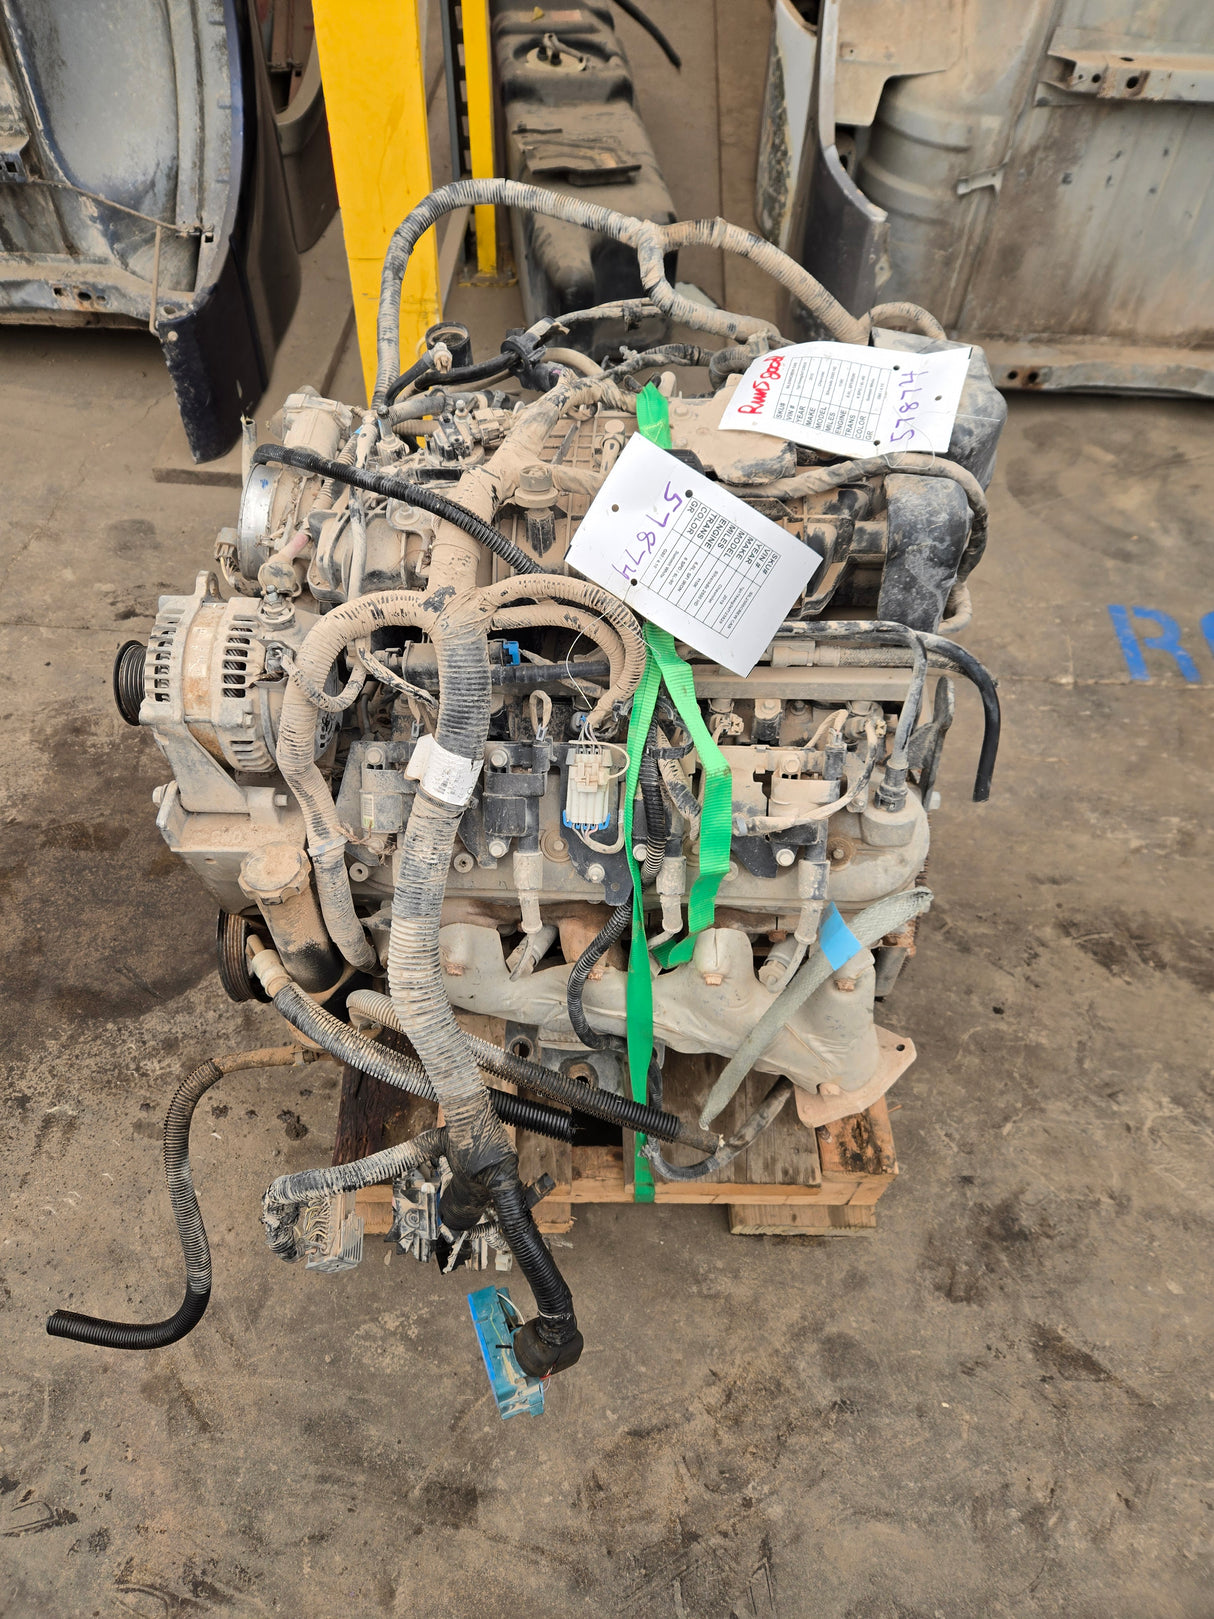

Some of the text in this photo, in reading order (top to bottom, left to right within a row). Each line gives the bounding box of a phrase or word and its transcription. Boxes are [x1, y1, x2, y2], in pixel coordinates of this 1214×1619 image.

[775, 401, 786, 419] SKU#
[785, 409, 794, 421] VIN
[794, 405, 806, 424] YEAR
[804, 406, 816, 426] MAKE
[814, 405, 827, 429] MODEL
[890, 371, 928, 443] 57874
[824, 411, 836, 432] MILES
[834, 408, 847, 435] ENGINE
[844, 413, 856, 436] TRANS
[854, 414, 866, 439] COLOR
[864, 429, 873, 440] GR
[686, 499, 699, 514] GR
[612, 481, 682, 580] 57874
[685, 505, 708, 535] COLOR
[696, 511, 717, 540] TRANS
[703, 517, 727, 550] ENGINE
[716, 523, 736, 550] MILES
[722, 529, 745, 560] MODEL
[735, 535, 753, 560] MAKE
[744, 541, 762, 565] YEAR
[754, 547, 770, 568] VIN #
[760, 552, 778, 575] SKU#
[1107, 604, 1214, 684] R
